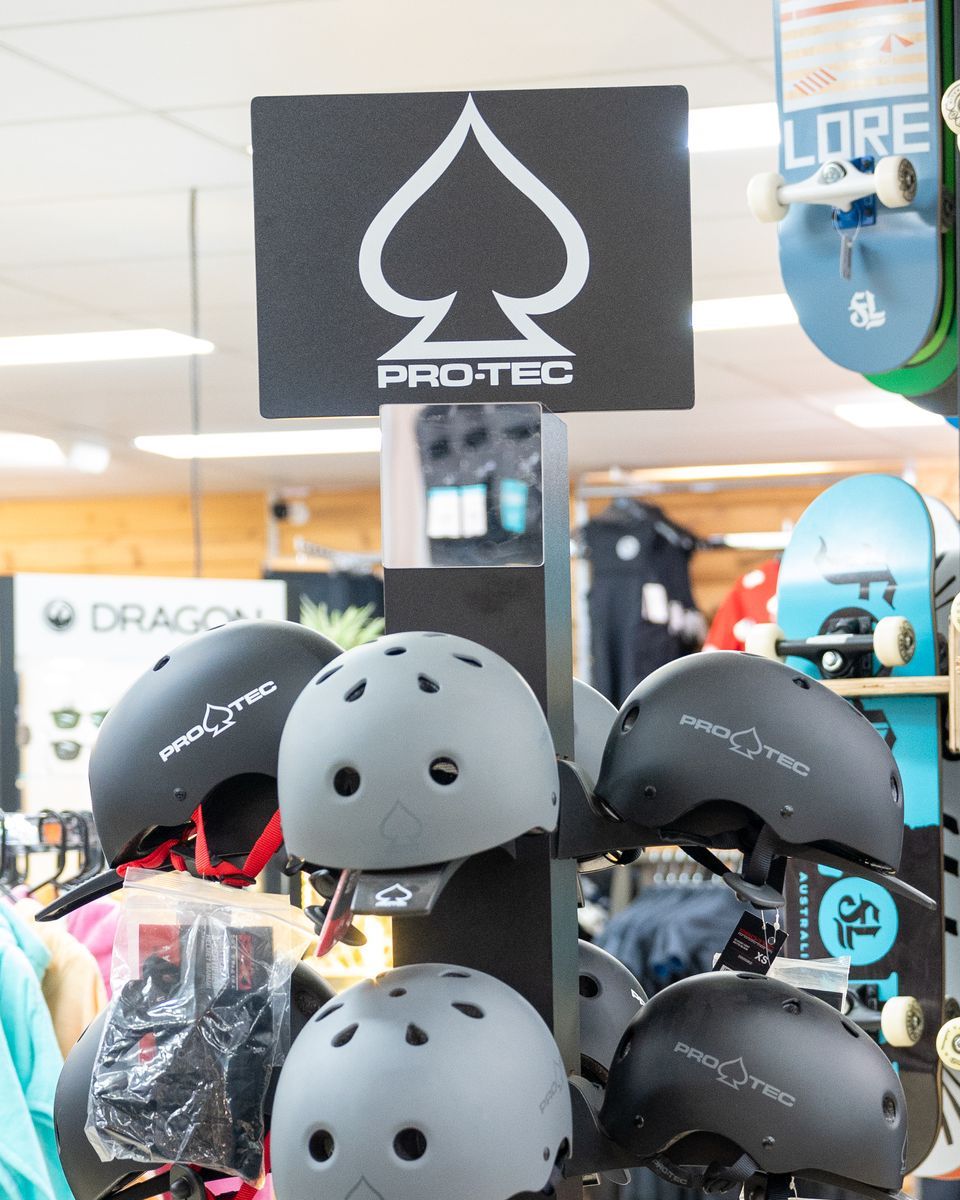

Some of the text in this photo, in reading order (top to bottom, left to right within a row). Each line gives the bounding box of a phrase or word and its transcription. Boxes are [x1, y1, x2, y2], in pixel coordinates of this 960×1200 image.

[377, 360, 574, 389] PRO-TEC
[798, 871, 810, 960] AUSTRALI
[754, 951, 769, 965] XS
